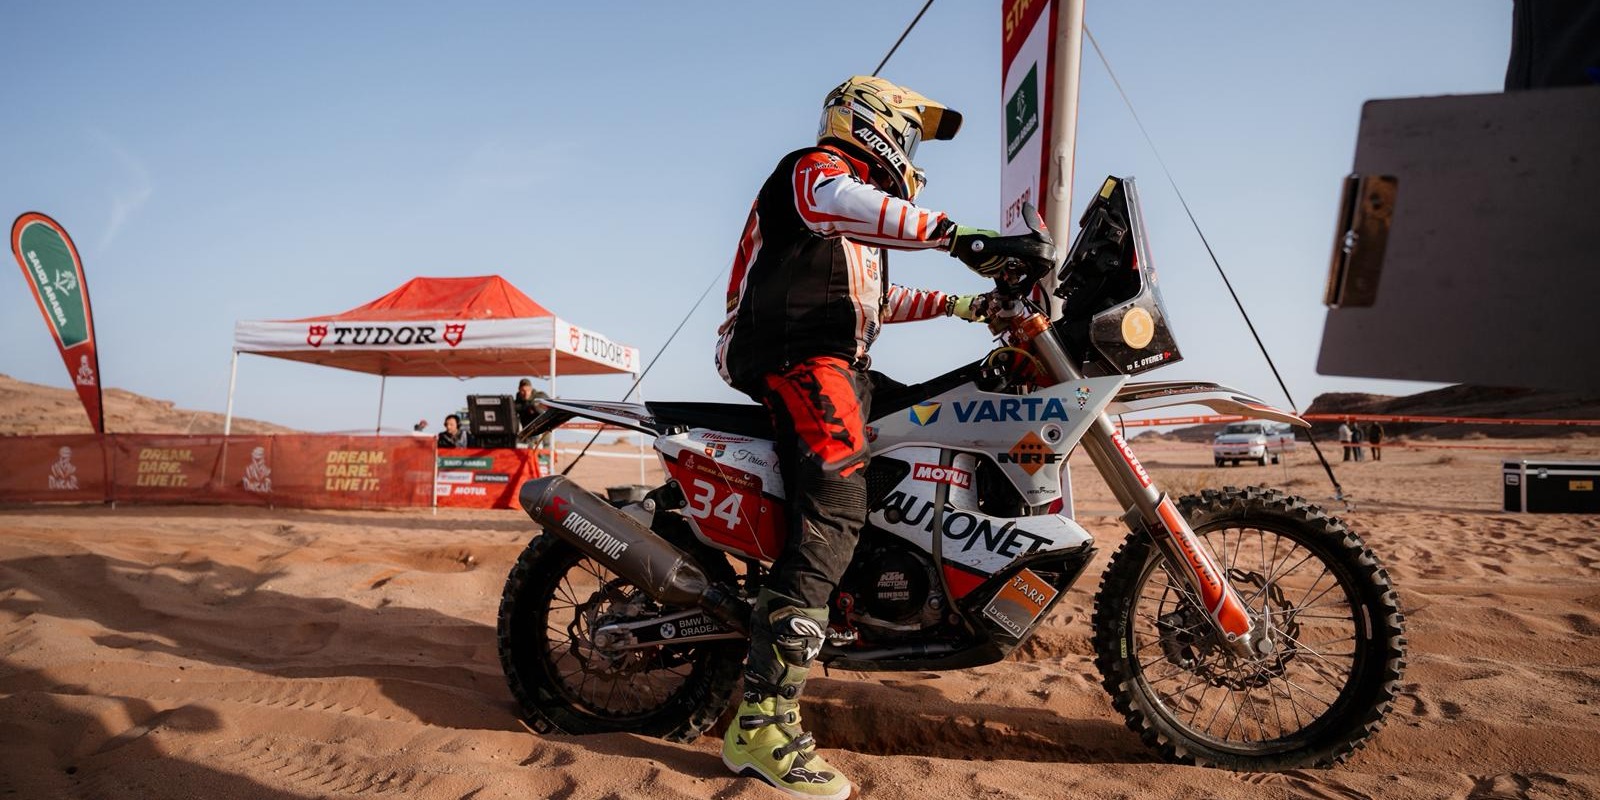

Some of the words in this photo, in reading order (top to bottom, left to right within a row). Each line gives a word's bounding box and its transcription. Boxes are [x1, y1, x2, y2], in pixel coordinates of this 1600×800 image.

[1005, 0, 1034, 42] STA
[855, 127, 907, 171] AUTONET
[1005, 197, 1020, 228] LET'S
[27, 250, 48, 285] SAUDI
[44, 285, 67, 327] ARABIA
[334, 326, 437, 345] TUDOR
[582, 331, 625, 366] TUDOR
[952, 397, 1070, 423] VARTA
[139, 448, 195, 462] DREAM.
[325, 450, 388, 464] DREAM.
[998, 452, 1064, 465] NRF
[1113, 432, 1152, 487] MOTUL
[137, 462, 182, 474] DARE.
[325, 465, 373, 477] DARE.
[915, 466, 970, 486] MOTUL
[48, 474, 79, 490] DAKAR
[136, 475, 168, 487] LIVE
[169, 475, 189, 487] IT.
[242, 477, 273, 493] DAKAR
[325, 479, 359, 491] LIVE
[361, 479, 381, 491] IT.
[454, 486, 487, 496] MOTUL
[686, 478, 744, 530] 34
[870, 491, 1054, 558] AUTONET
[880, 571, 904, 581] KTM
[1013, 576, 1045, 607] TARR
[679, 618, 703, 629] BMW
[988, 605, 1022, 633] beton
